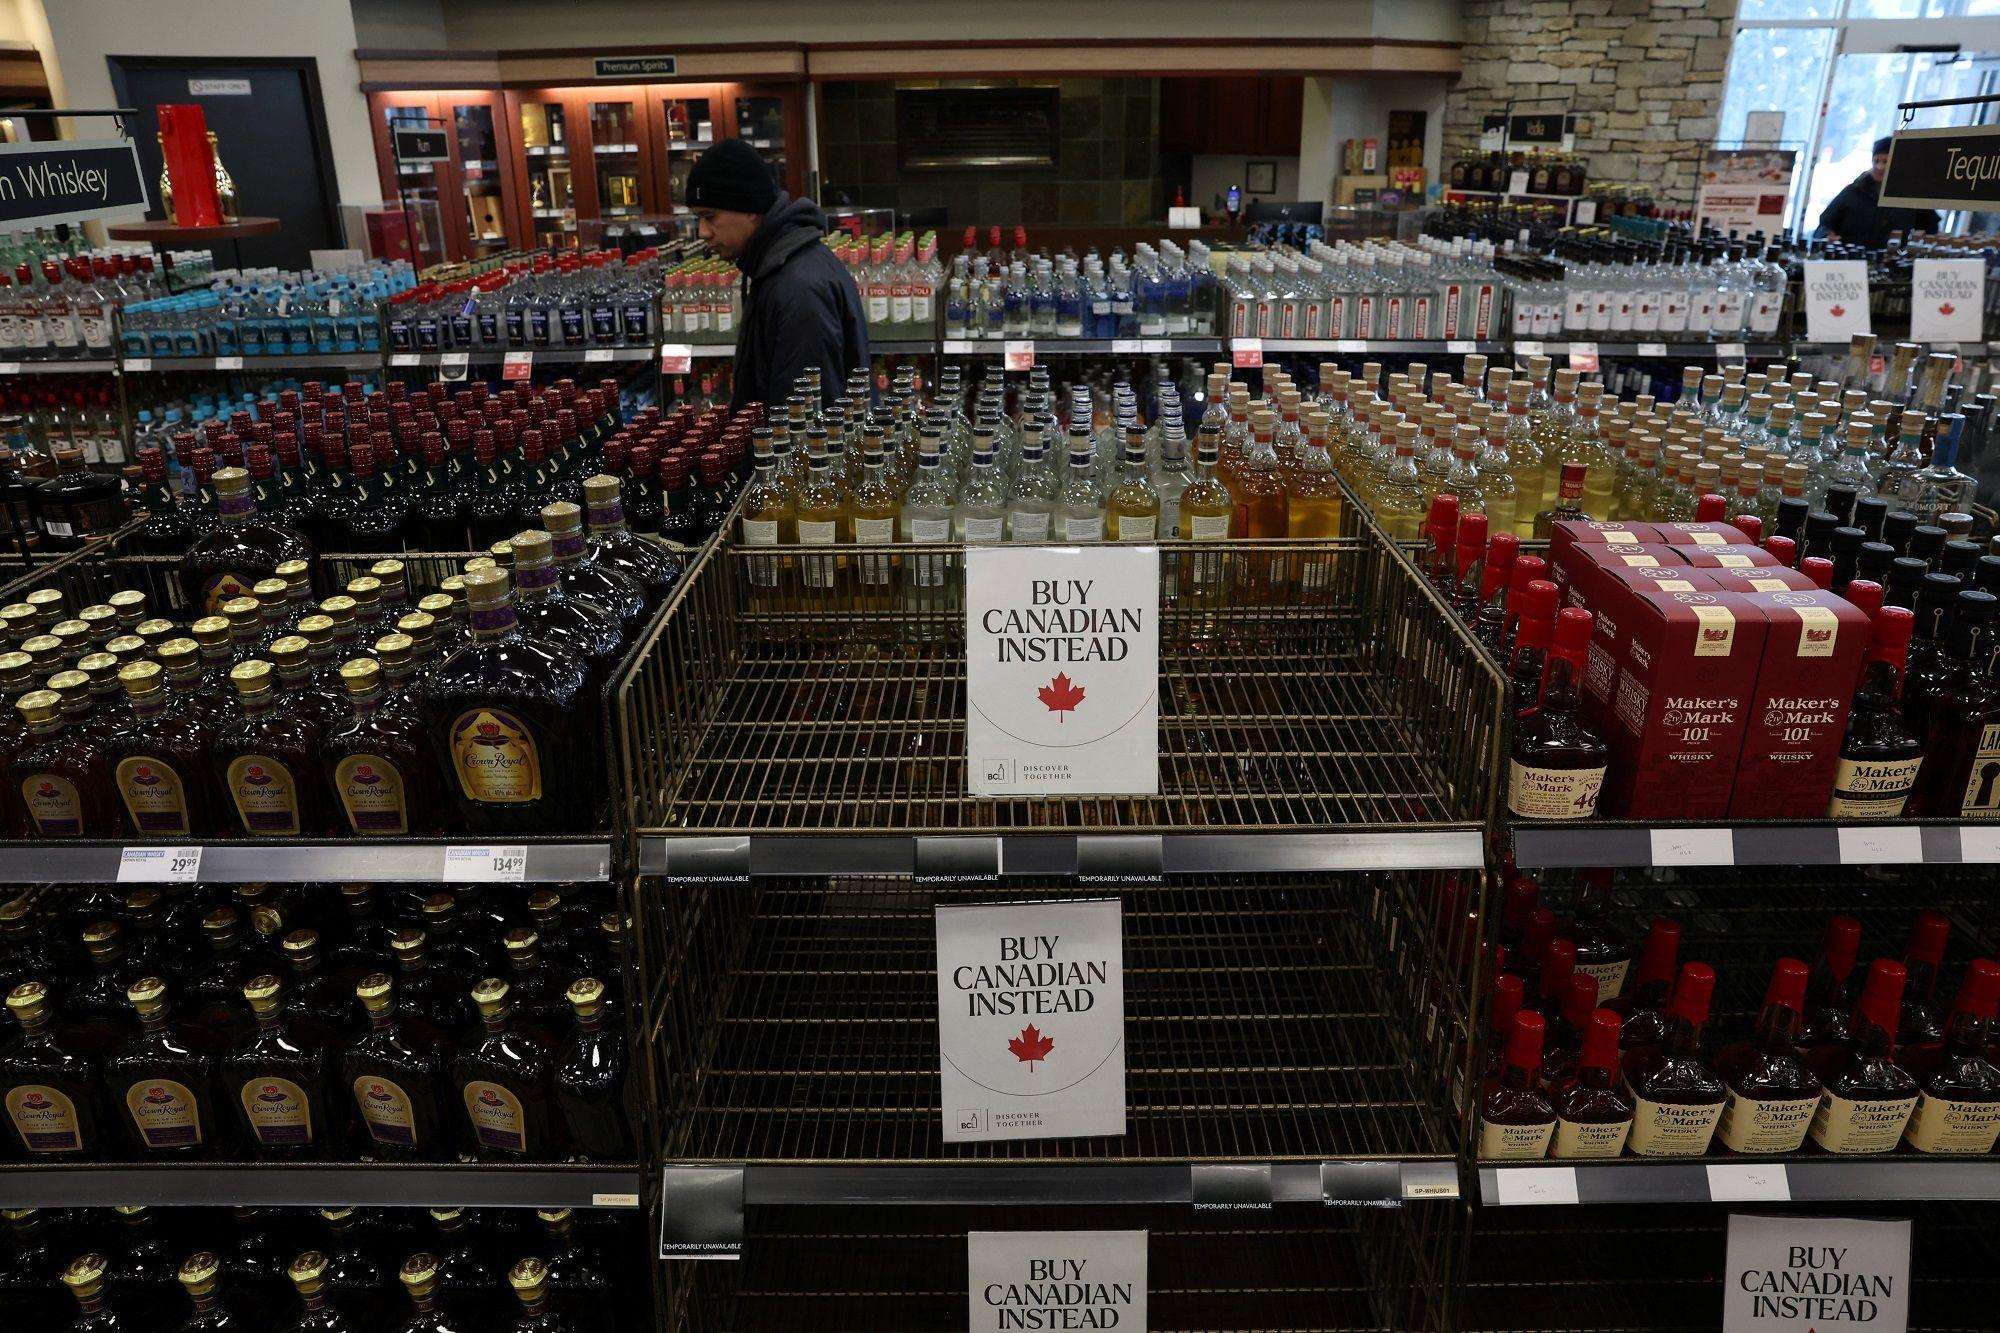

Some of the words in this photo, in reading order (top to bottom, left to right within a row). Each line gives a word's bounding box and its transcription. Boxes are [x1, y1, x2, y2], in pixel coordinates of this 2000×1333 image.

[602, 61, 640, 73] Premium
[641, 60, 668, 73] Spirits
[16, 159, 108, 201] Whiskey
[1825, 273, 1846, 282] BUY
[1936, 271, 1959, 280] BUY
[1810, 282, 1864, 292] CANADIAN
[1918, 280, 1978, 290] CANADIAN
[1816, 292, 1859, 301] INSTEAD
[1923, 290, 1972, 299] INSTEAD
[580, 435, 588, 449] J
[308, 460, 317, 475] J
[407, 458, 417, 474] J
[503, 459, 513, 474] J
[550, 458, 559, 474] J
[282, 471, 293, 487] J
[332, 472, 342, 488] J
[383, 471, 394, 488] J
[488, 468, 497, 484] J
[536, 469, 546, 485] J
[160, 486, 171, 503] J
[359, 485, 369, 502] J
[1032, 580, 1093, 605] BUY
[982, 608, 1142, 634] CANADIAN
[998, 637, 1128, 662] INSTEAD
[1619, 677, 1648, 712] WHISKY
[1664, 697, 1738, 709] Maker's
[1766, 697, 1839, 709] Maker's
[1682, 712, 1734, 724] Mark
[1784, 712, 1835, 724] Mark
[1680, 727, 1709, 741] 101
[1781, 727, 1810, 741] 101
[465, 753, 494, 769] Crown
[489, 752, 523, 769] Royal
[1524, 771, 1575, 783] Maker's
[1852, 764, 1917, 777] Maker's
[1536, 783, 1573, 793] Mark
[1867, 777, 1912, 790] Mark
[128, 786, 150, 798] Crown
[148, 786, 173, 798] Royal
[239, 785, 262, 798] Crown
[260, 785, 285, 798] Royal
[347, 785, 370, 797] Crown
[368, 785, 393, 798] Royal
[1573, 790, 1601, 809] 46
[957, 874, 998, 882] UNAVAILABLE
[1000, 935, 1060, 961] BUY
[953, 961, 1107, 990] CANADIAN
[1577, 964, 1623, 974] Maker's
[1597, 973, 1620, 982] ark
[968, 988, 1094, 1017] INSTEAD
[138, 1105, 162, 1116] Crown
[160, 1104, 187, 1115] Royal
[252, 1103, 275, 1114] Crown
[272, 1102, 300, 1114] Royal
[363, 1100, 384, 1111] Crown
[382, 1103, 404, 1114] Royal
[472, 1104, 493, 1115] Crown
[492, 1107, 515, 1119] Royal
[1656, 1106, 1716, 1117] Maker's
[1757, 1103, 1814, 1114] Maker's
[1853, 1102, 1911, 1113] Maker's
[17, 1110, 41, 1120] Crown
[39, 1110, 66, 1121] Royal
[995, 1112, 1040, 1120] DISCOVER
[1671, 1117, 1712, 1126] Mark
[1771, 1113, 1809, 1122] Mark
[1868, 1112, 1907, 1122] Mark
[1963, 1113, 2000, 1122] Mark
[996, 1120, 1043, 1128] TOGETHER
[1788, 1246, 1848, 1269] BUY
[1030, 1259, 1087, 1281] BUY
[1740, 1270, 1893, 1297] CANADIAN
[984, 1283, 1132, 1305] CANADIAN
[1753, 1296, 1878, 1322] INSTEAD
[998, 1308, 1119, 1329] INSTEAD
